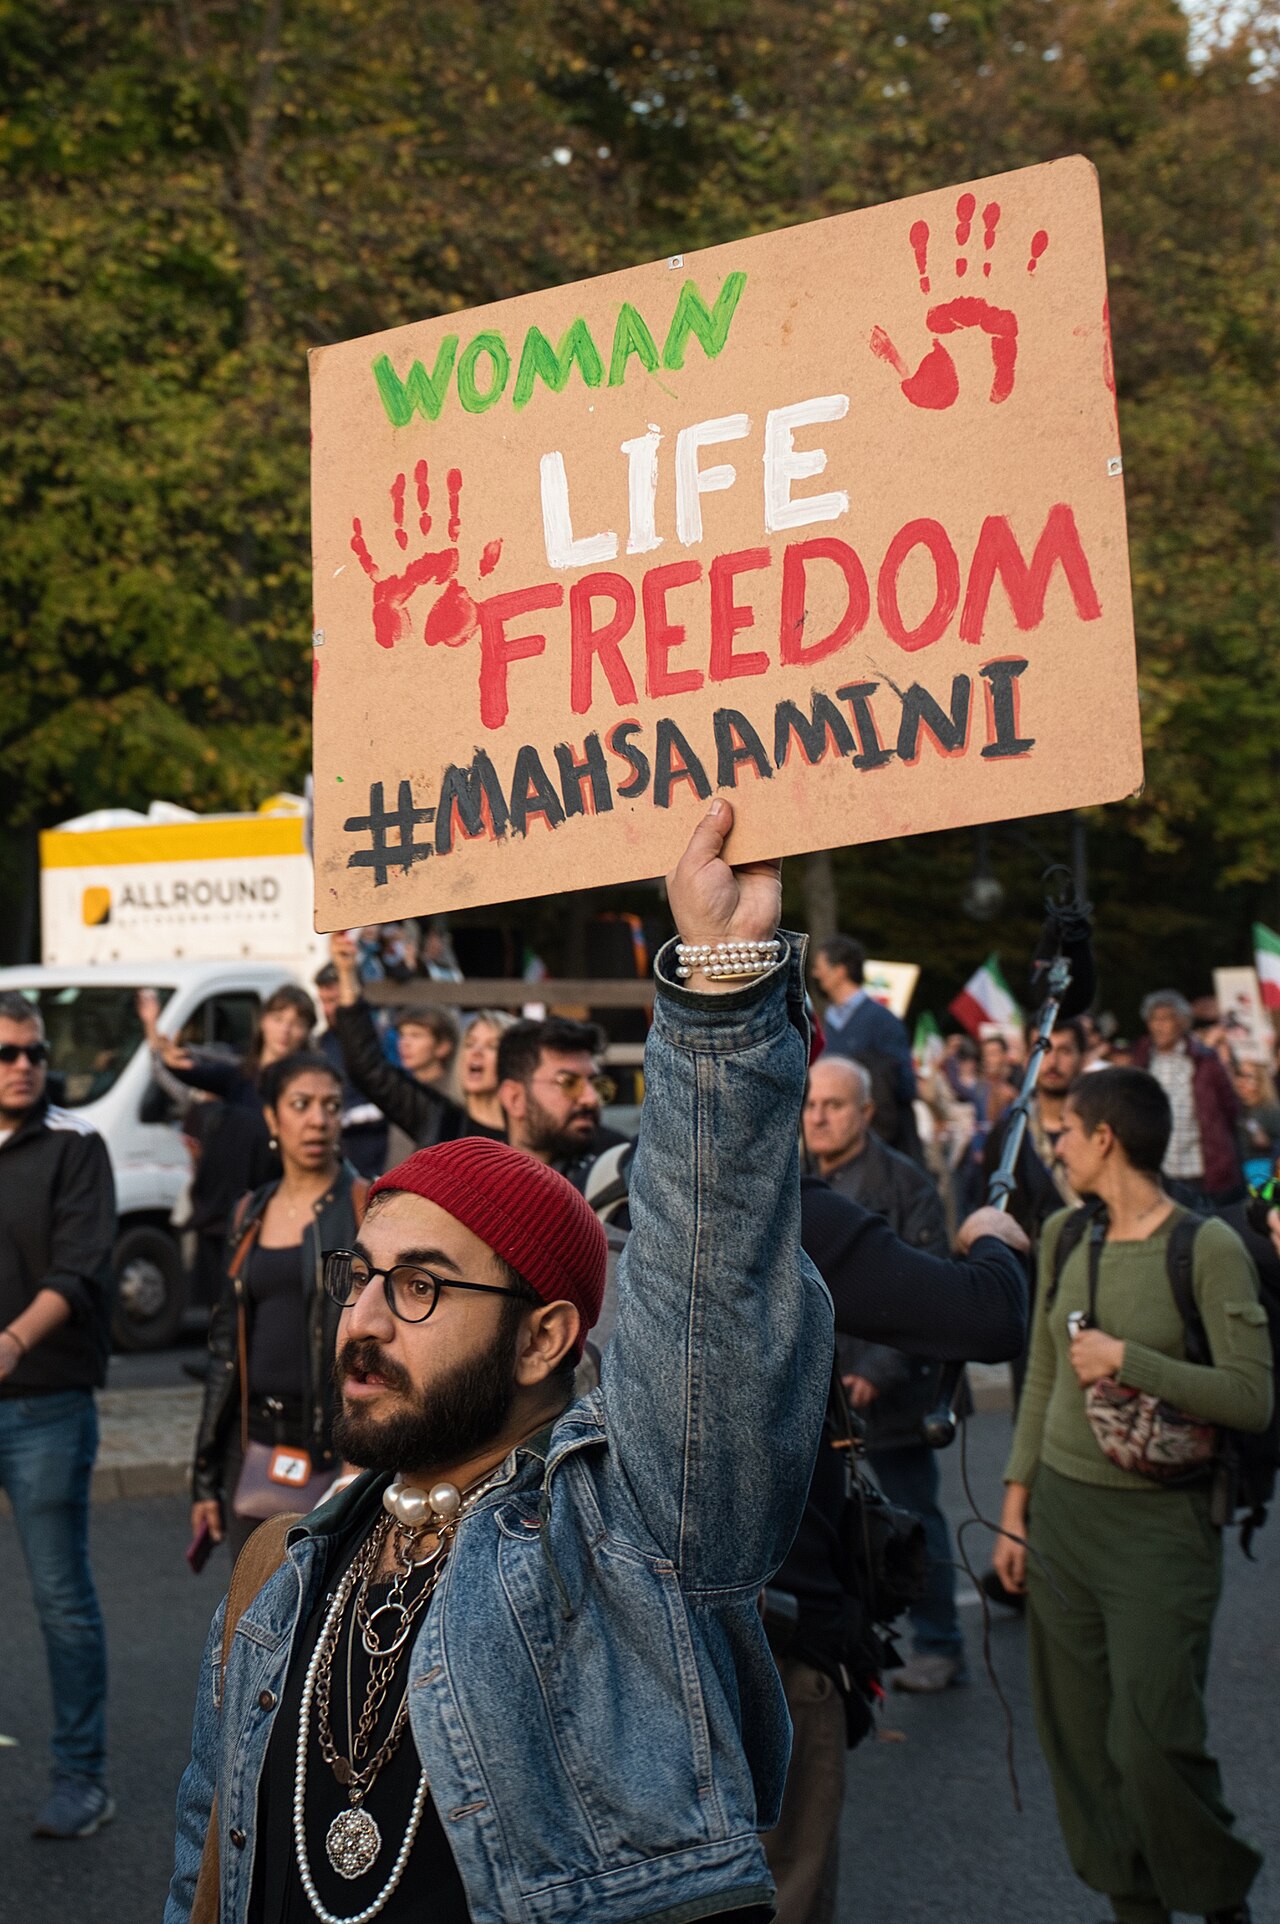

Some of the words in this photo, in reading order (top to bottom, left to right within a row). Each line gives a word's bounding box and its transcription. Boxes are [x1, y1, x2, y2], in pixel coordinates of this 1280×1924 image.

[373, 271, 747, 427] WOMAN
[540, 394, 850, 569] LIFE
[477, 503, 1102, 730] FREEDOM
[343, 657, 1035, 886] #MAHSAAMINI
[119, 877, 280, 908] ALLROUND
